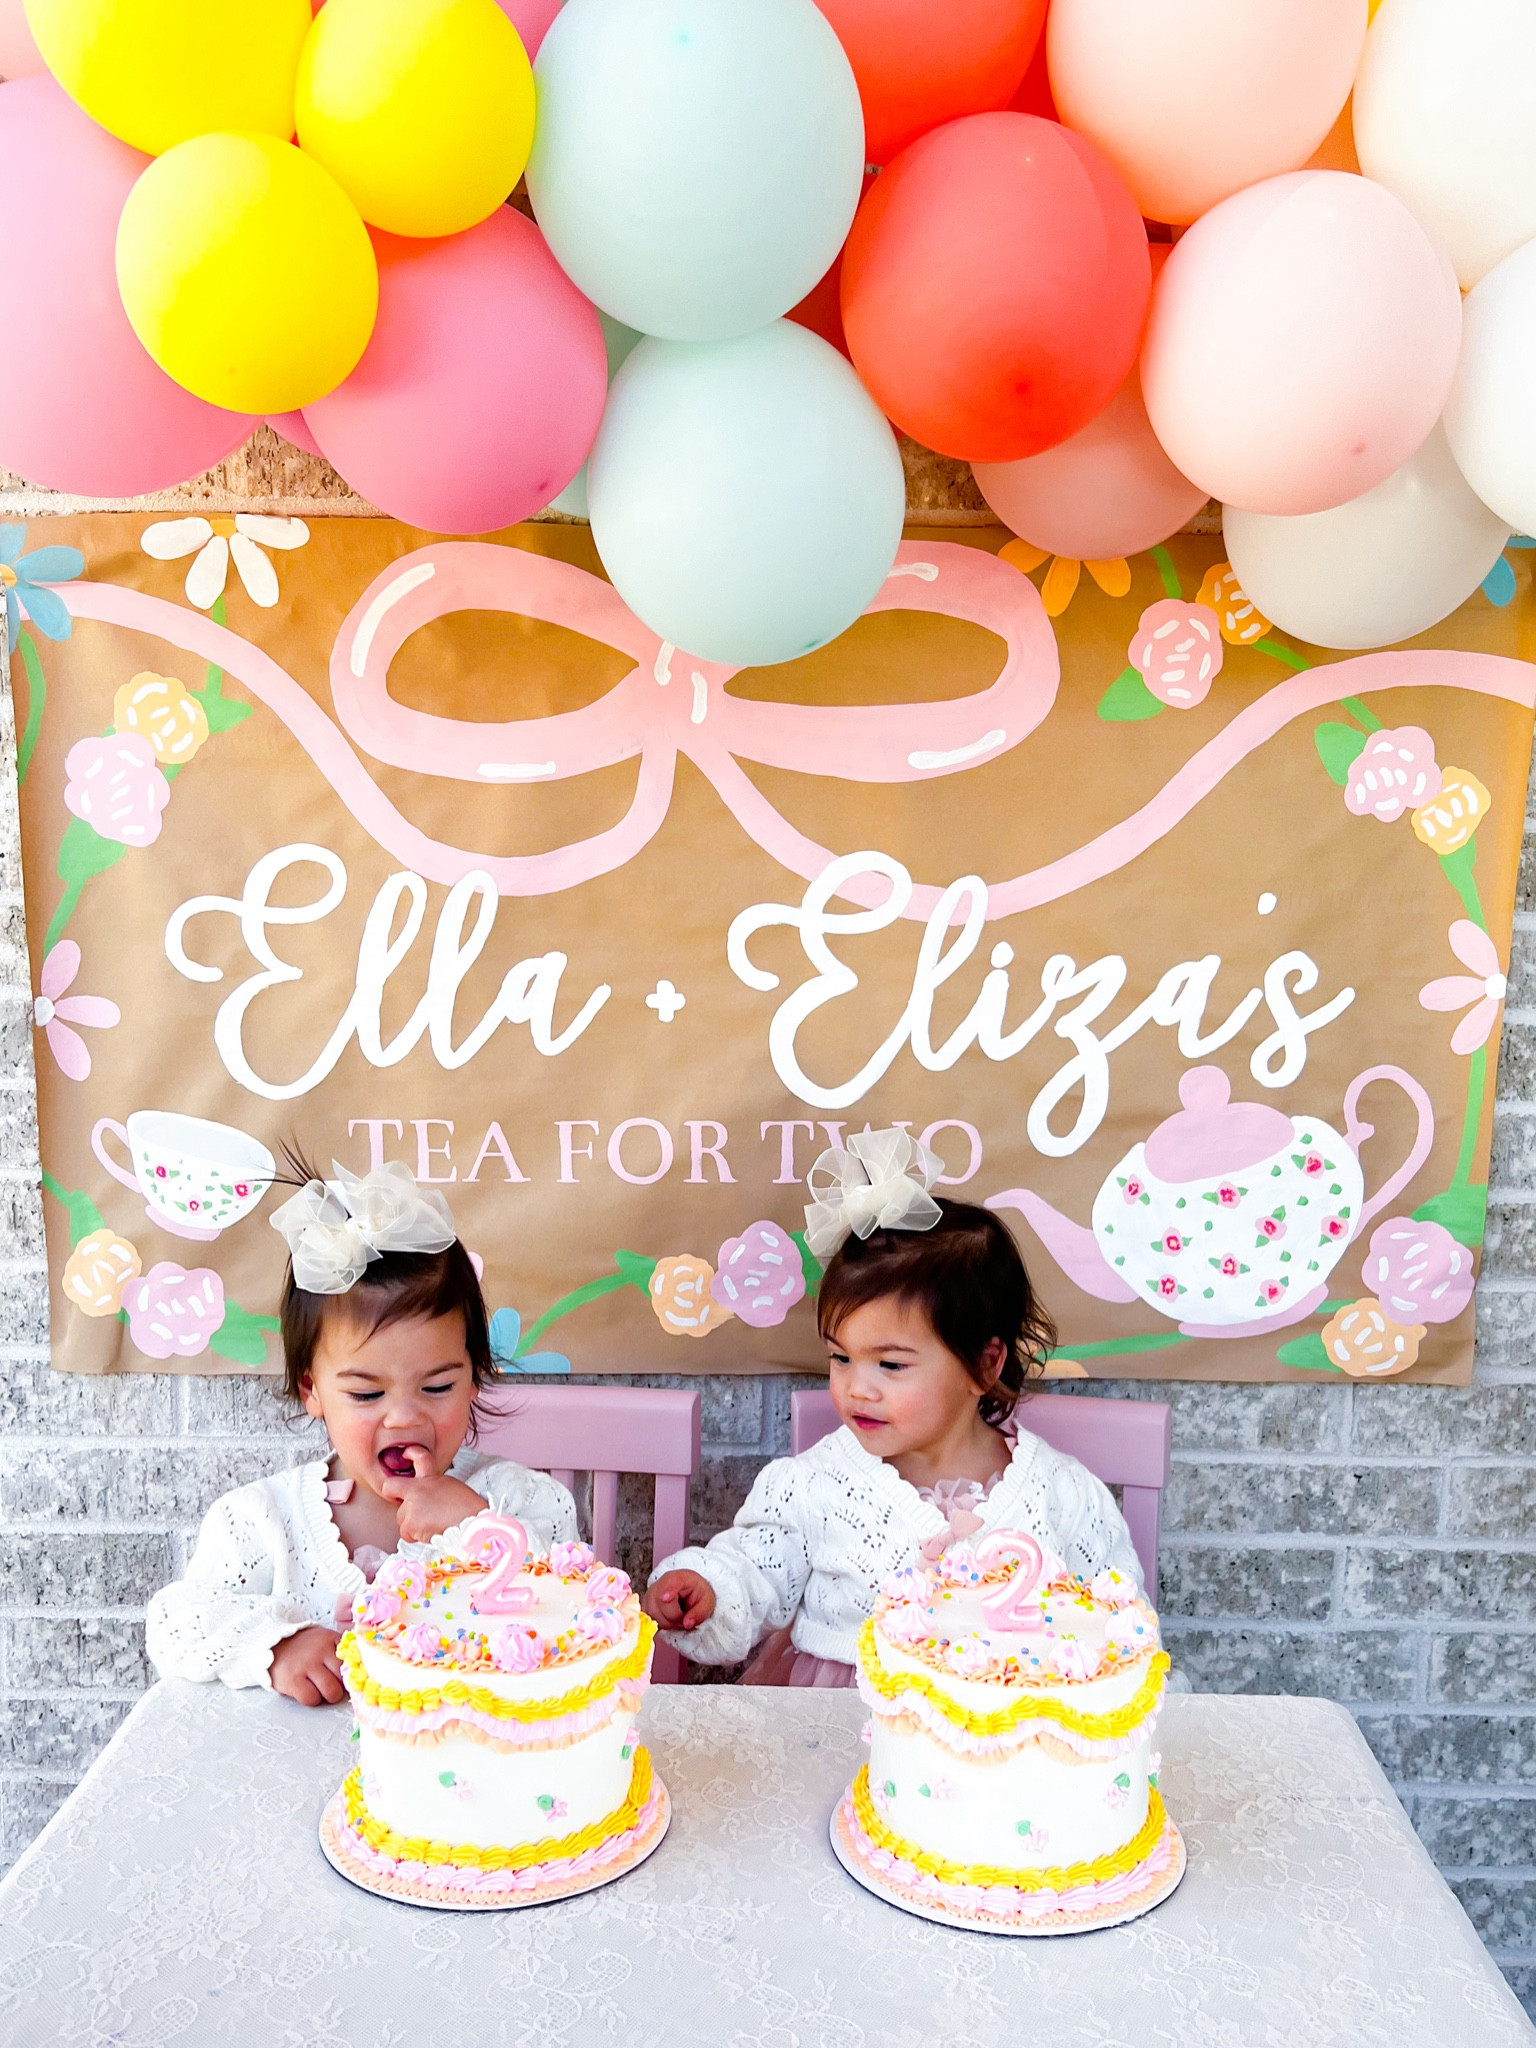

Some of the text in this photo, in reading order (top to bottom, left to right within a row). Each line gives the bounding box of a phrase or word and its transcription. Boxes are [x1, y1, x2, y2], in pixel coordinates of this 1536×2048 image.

[164, 842, 611, 1100] Ella
[727, 850, 1355, 1157] Eliza's
[348, 1119, 531, 1183] TEA
[554, 1117, 739, 1185] FOR
[463, 1511, 534, 1615] 2
[975, 1528, 1046, 1633] 2
